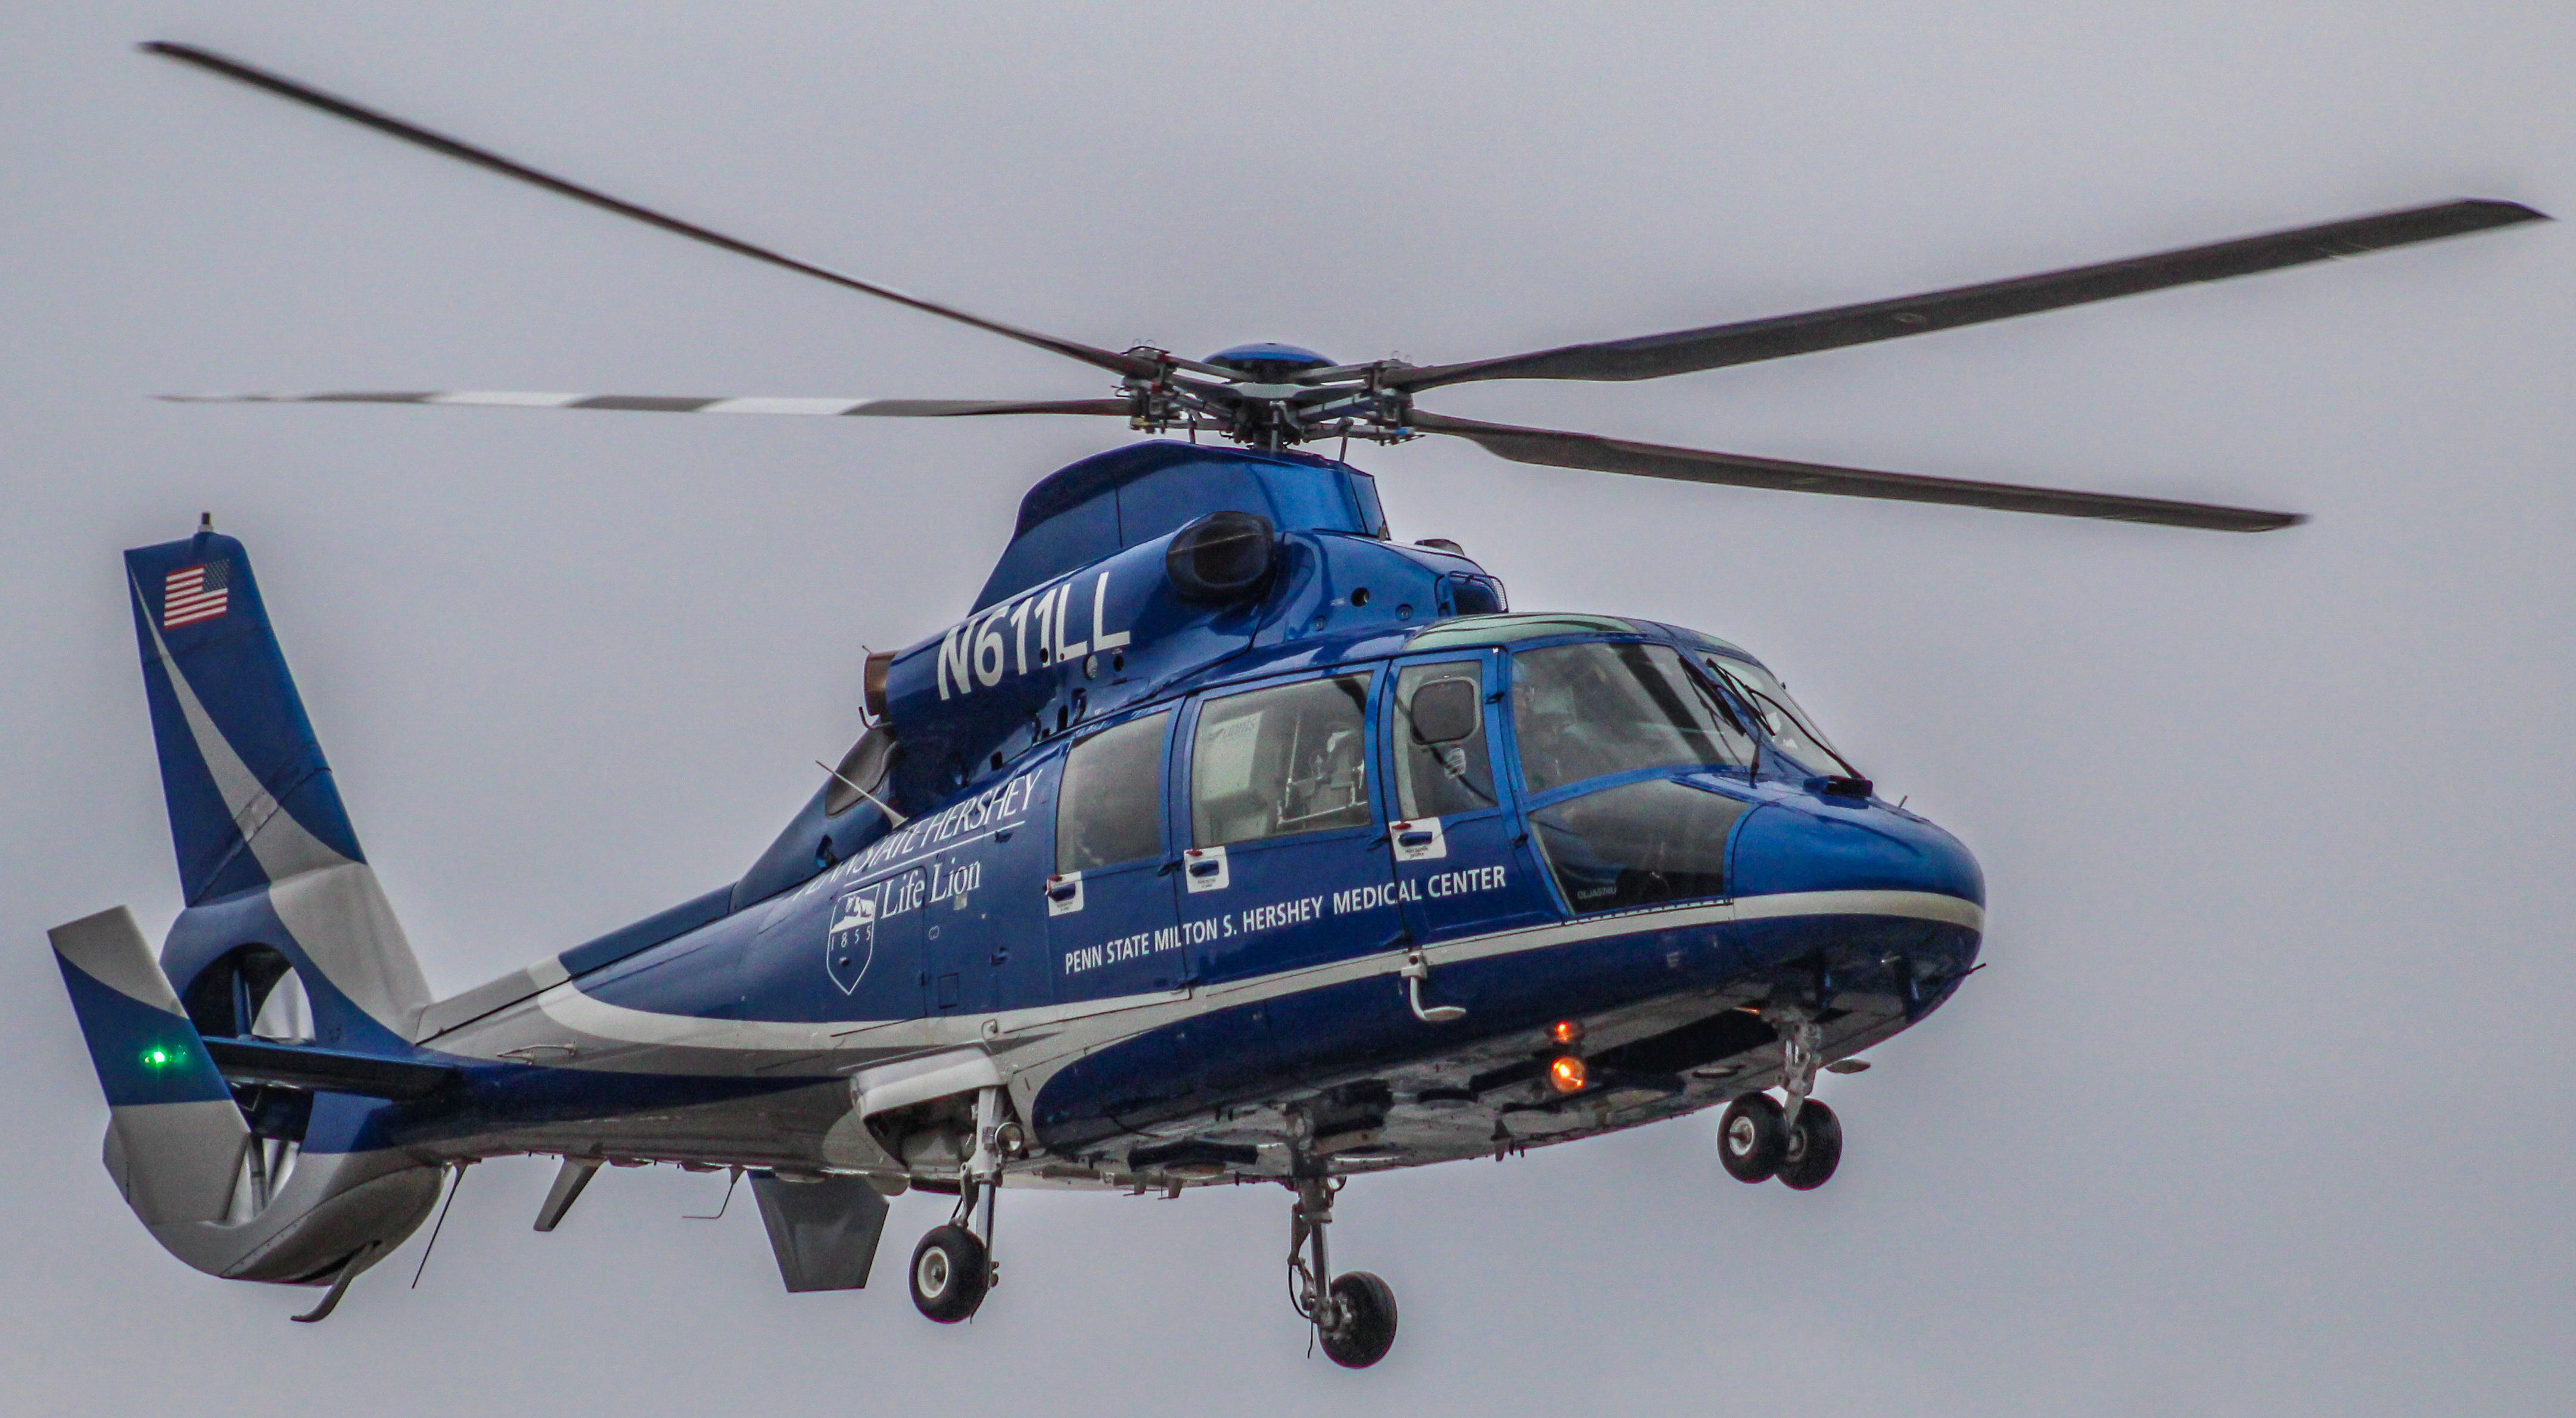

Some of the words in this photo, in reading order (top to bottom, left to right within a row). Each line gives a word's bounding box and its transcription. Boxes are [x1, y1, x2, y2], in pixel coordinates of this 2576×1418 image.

[937, 572, 1131, 701] N611LL
[920, 769, 1043, 847] HERSHEY
[880, 870, 925, 920] Life
[929, 858, 981, 902] Lion
[1065, 945, 1102, 975] PENN
[1107, 933, 1149, 964] STATE
[1155, 918, 1218, 952] MILTON
[1223, 915, 1237, 938] S.
[1243, 895, 1323, 933] HERSHEY
[1333, 878, 1423, 915] MEDICAL
[1428, 865, 1506, 897] CENTER
